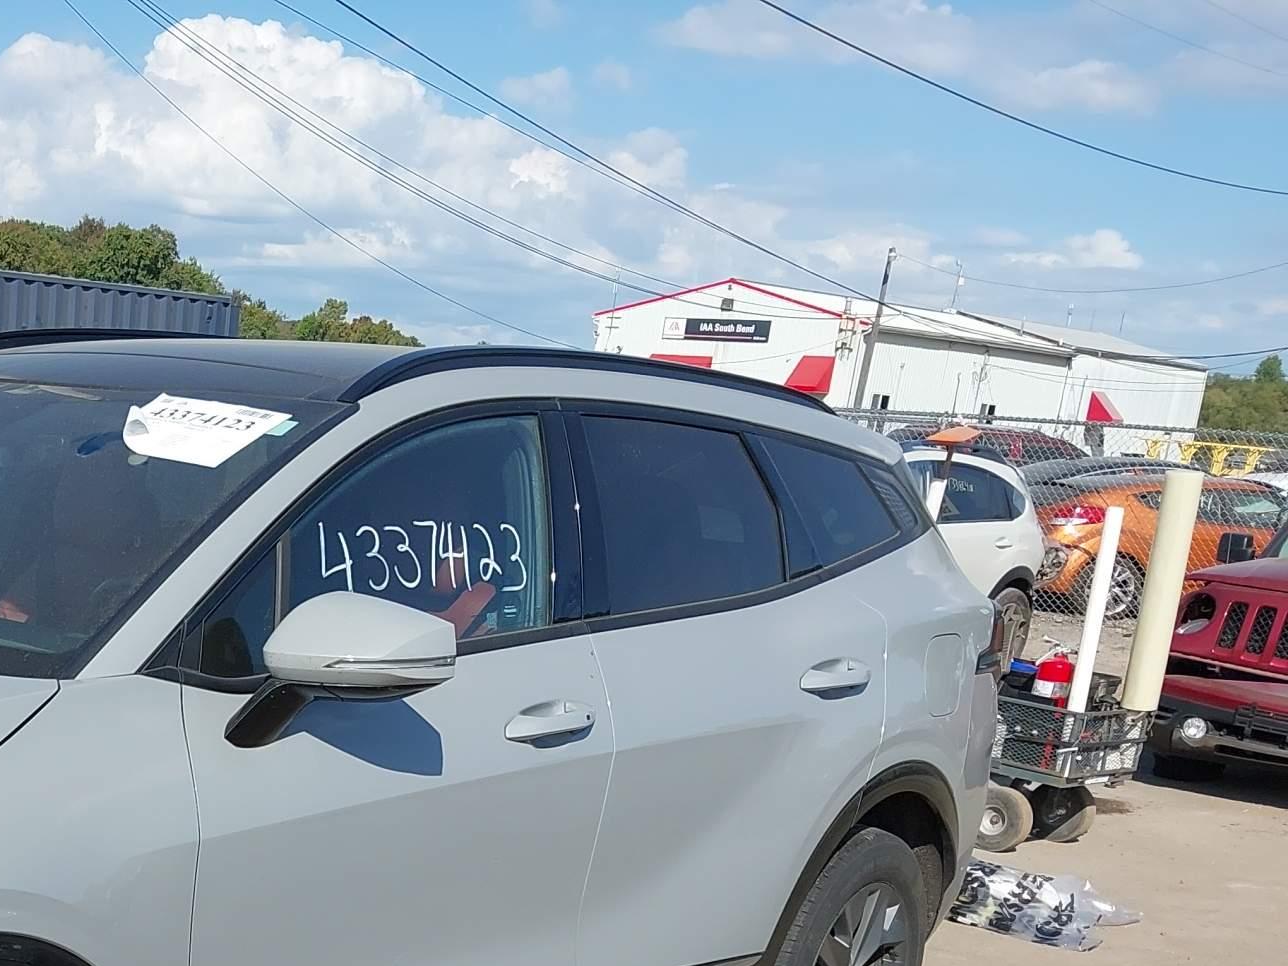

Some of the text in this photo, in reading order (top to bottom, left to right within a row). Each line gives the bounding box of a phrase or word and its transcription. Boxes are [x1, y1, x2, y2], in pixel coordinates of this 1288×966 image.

[699, 322, 756, 334] IAA South Bend
[150, 407, 256, 432] 43374123
[318, 520, 527, 592] 43374123
